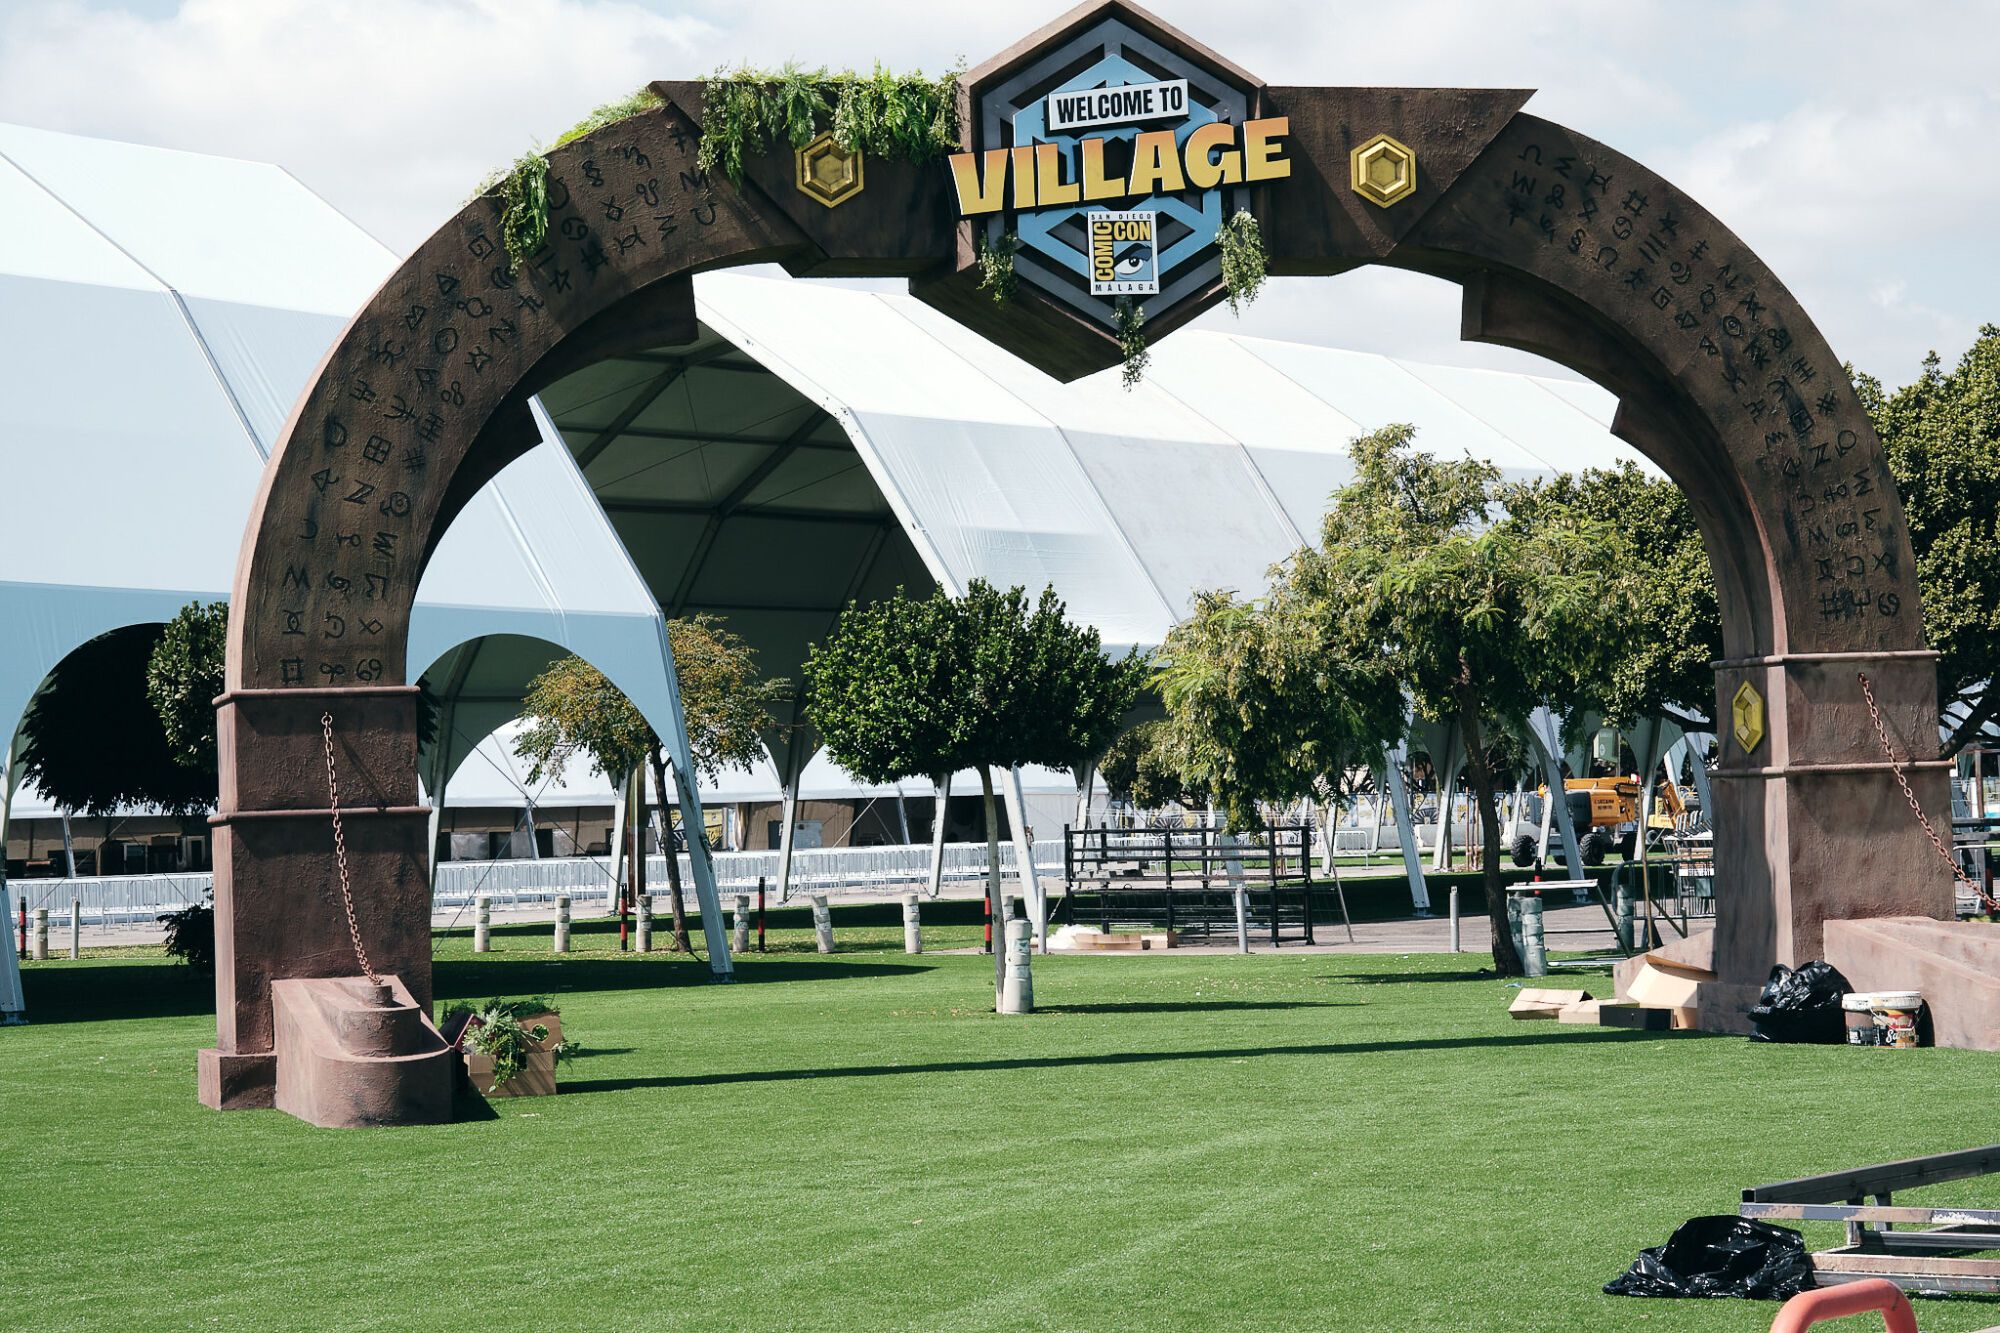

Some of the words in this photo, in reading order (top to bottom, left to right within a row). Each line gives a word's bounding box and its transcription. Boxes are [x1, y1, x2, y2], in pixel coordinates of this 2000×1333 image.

[1057, 89, 1153, 123] WELCOME
[1159, 86, 1182, 112] TO
[948, 116, 1291, 215] VILLAGE
[1093, 222, 1115, 281] COMIC
[1113, 221, 1151, 241] CON
